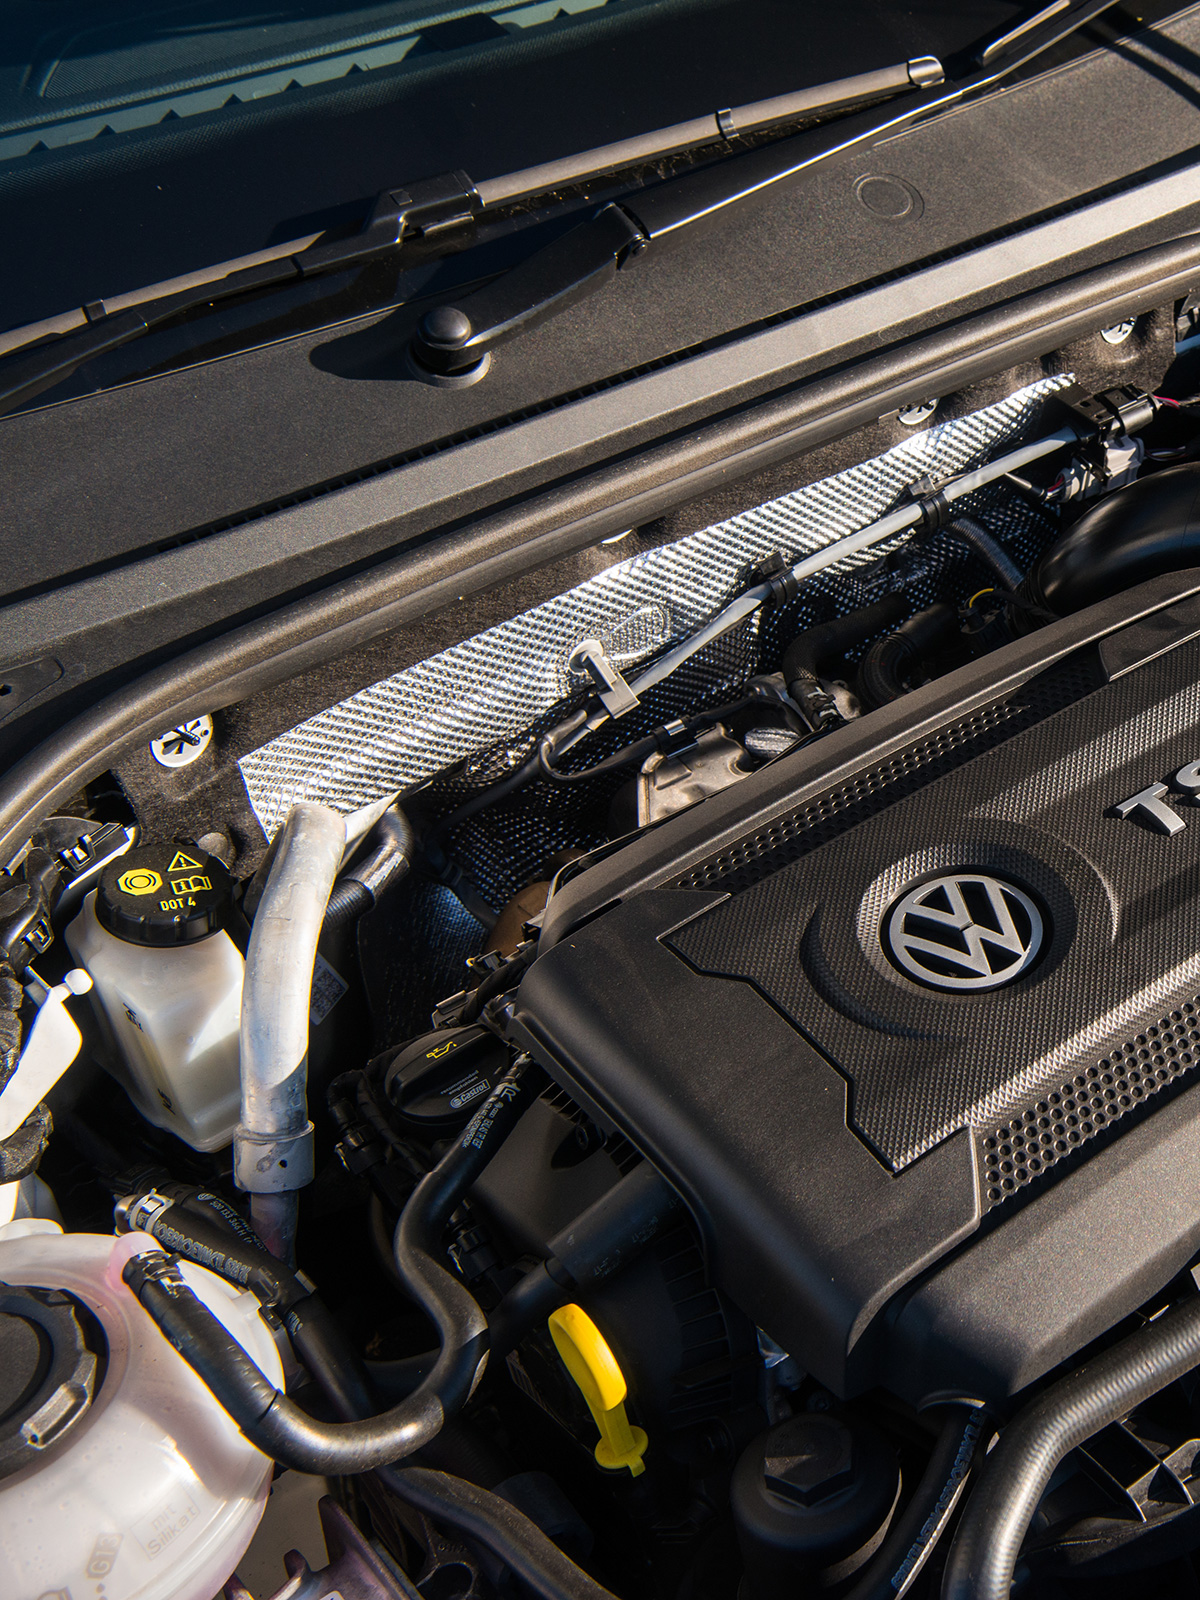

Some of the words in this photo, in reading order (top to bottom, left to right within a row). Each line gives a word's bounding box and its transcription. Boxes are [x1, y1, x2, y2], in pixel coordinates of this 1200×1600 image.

[160, 898, 184, 911] DOT
[187, 896, 197, 907] 4
[889, 874, 1043, 992] VW
[459, 1081, 488, 1102] Castrol
[148, 1505, 197, 1556] Silikat
[152, 1504, 178, 1531] mit
[90, 1536, 119, 1574] G13
